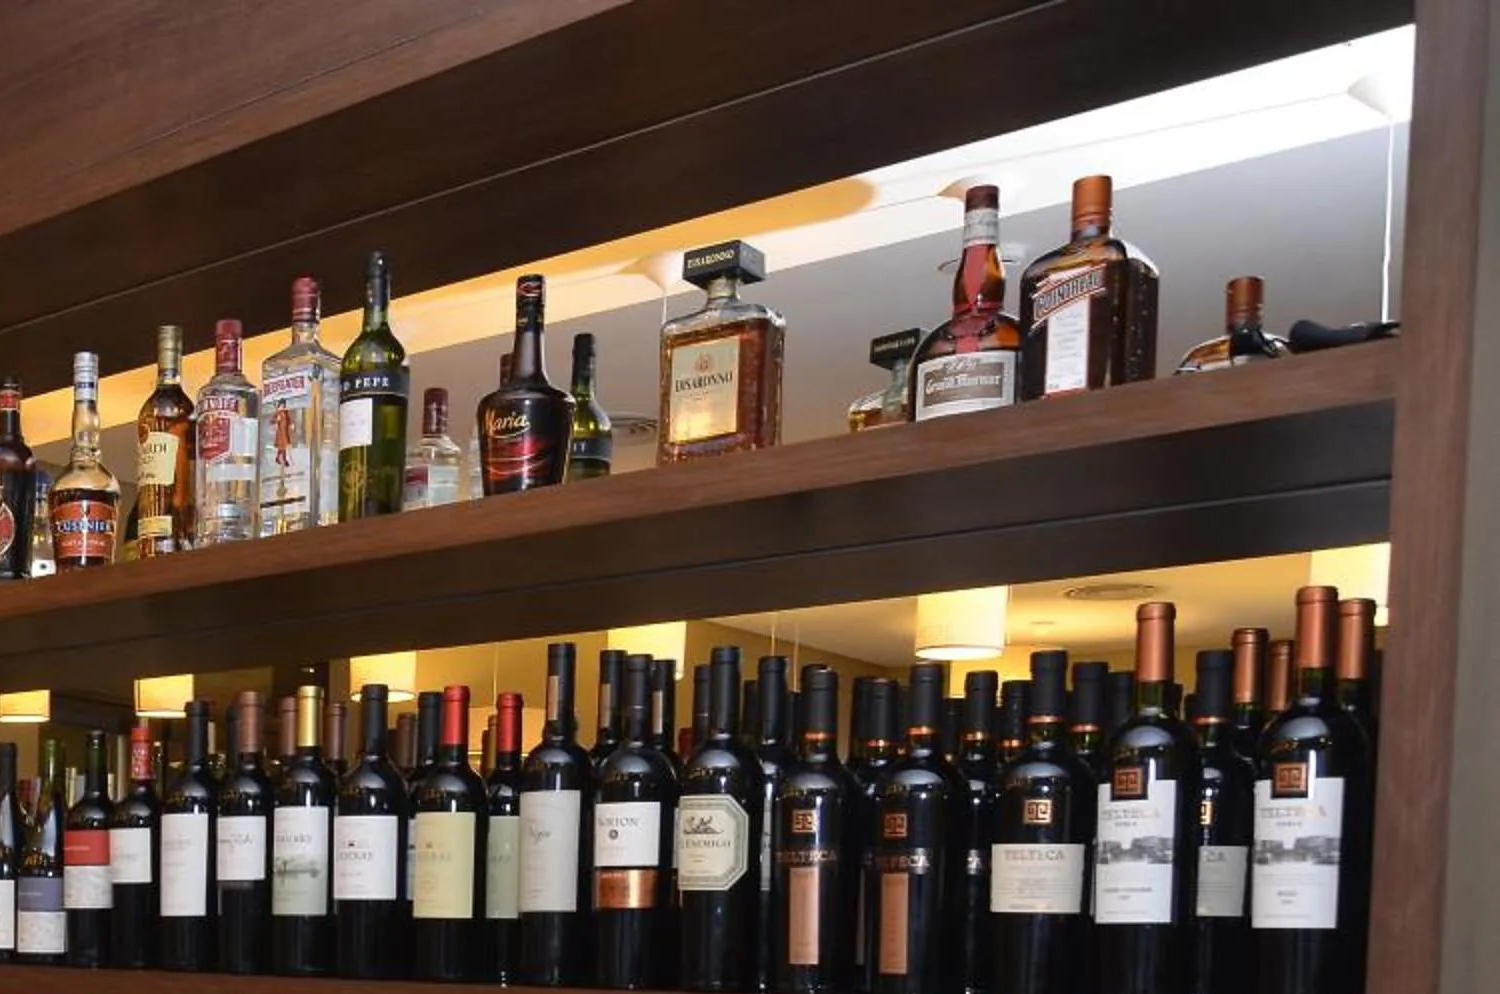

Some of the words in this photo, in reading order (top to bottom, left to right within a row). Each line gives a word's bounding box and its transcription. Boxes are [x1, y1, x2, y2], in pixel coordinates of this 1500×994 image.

[686, 249, 735, 269] DISARONNO
[355, 377, 390, 389] PEPE
[674, 370, 733, 393] DISARONNO
[1004, 849, 1066, 861] TELTECA
